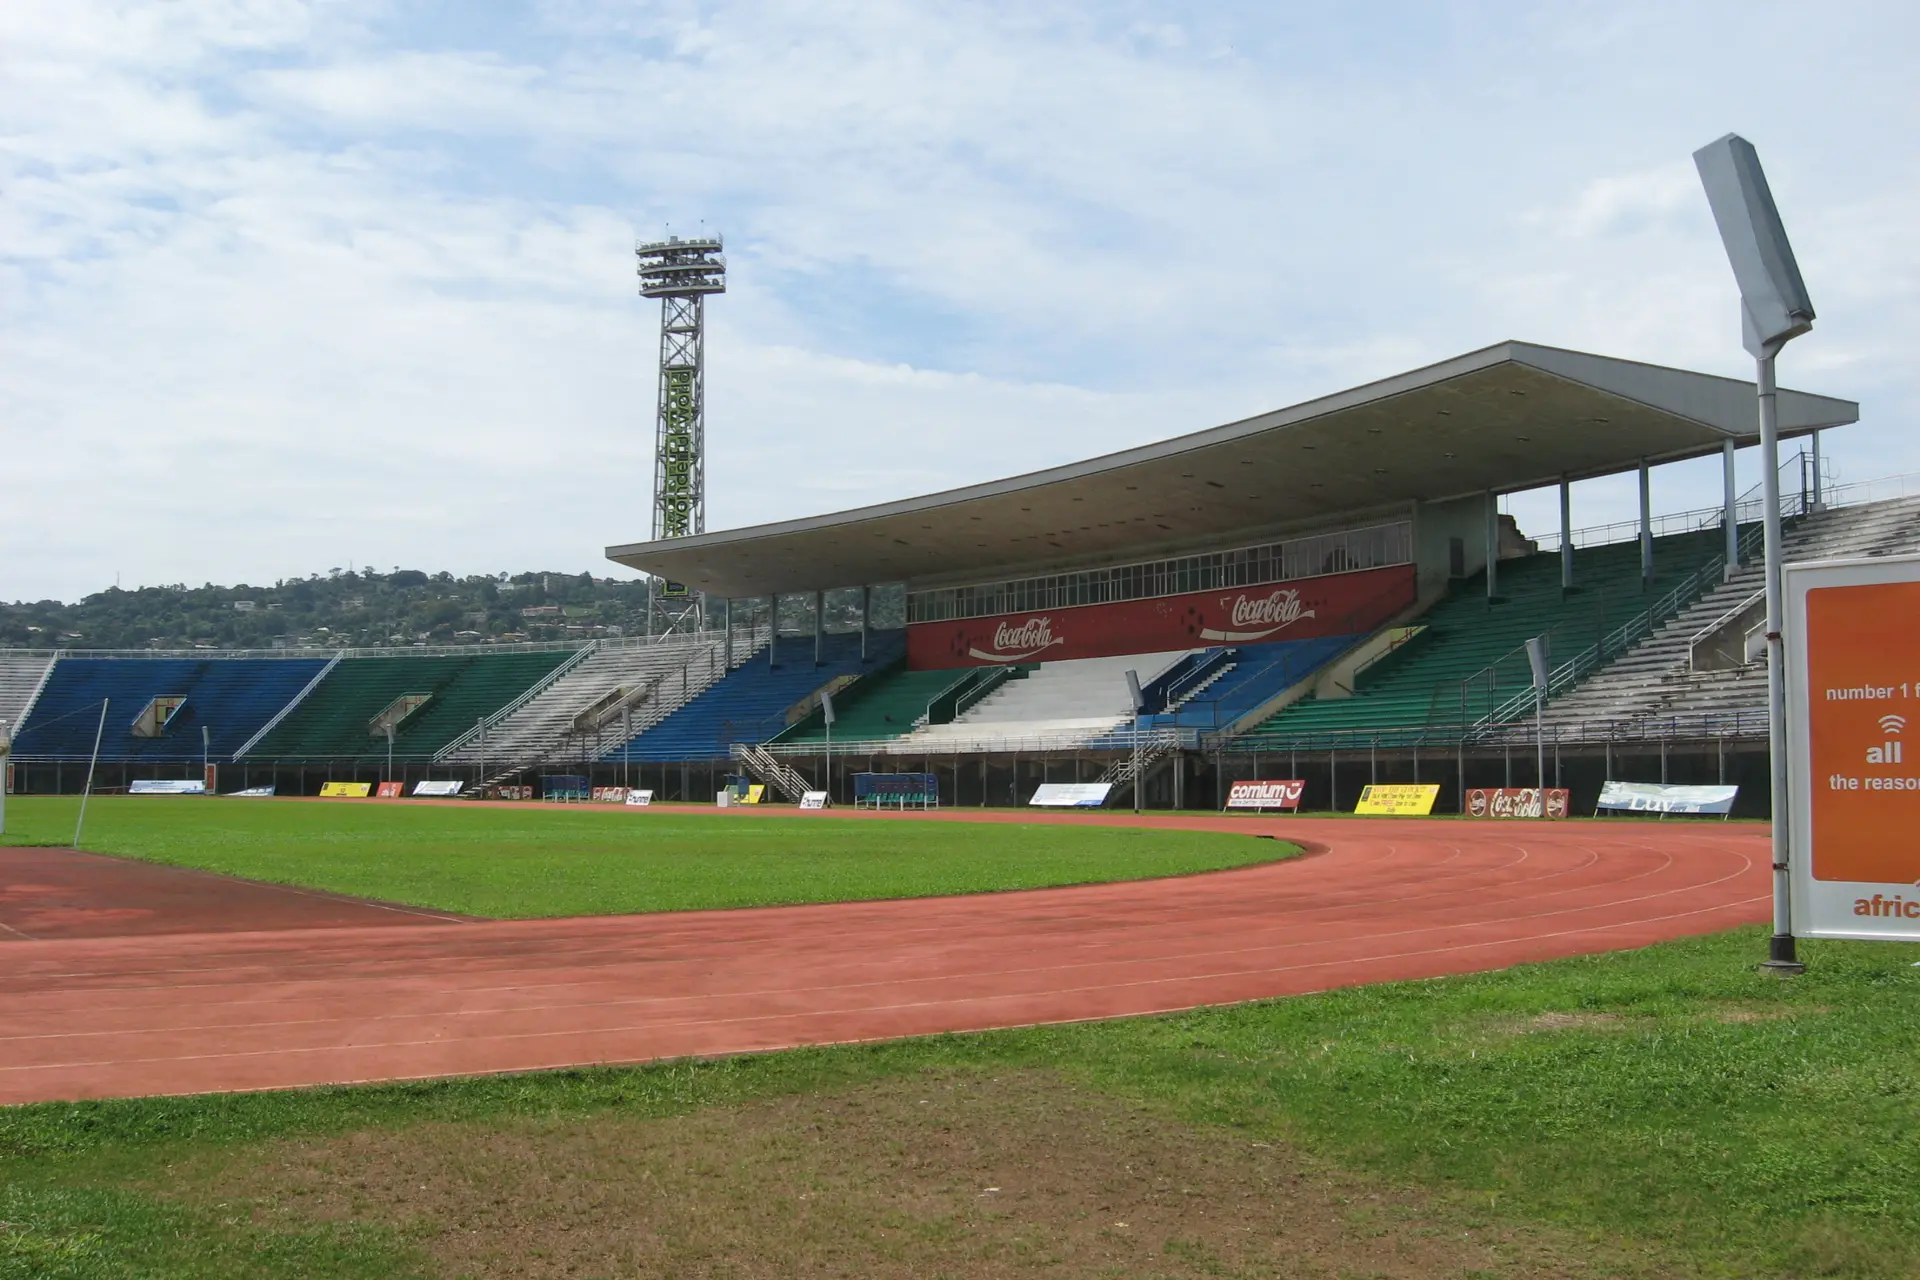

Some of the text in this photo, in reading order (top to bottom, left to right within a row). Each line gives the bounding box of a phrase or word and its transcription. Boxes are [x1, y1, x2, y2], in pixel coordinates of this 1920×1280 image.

[669, 371, 690, 424] world
[1232, 588, 1301, 627] Coca-Cola
[994, 616, 1052, 650] Coca-Cola
[1826, 684, 1894, 700] number
[1900, 683, 1908, 698] 1
[1865, 741, 1902, 763] all
[1230, 781, 1286, 798] comium
[1829, 774, 1920, 790] the reaso
[1853, 894, 1920, 918] afric
